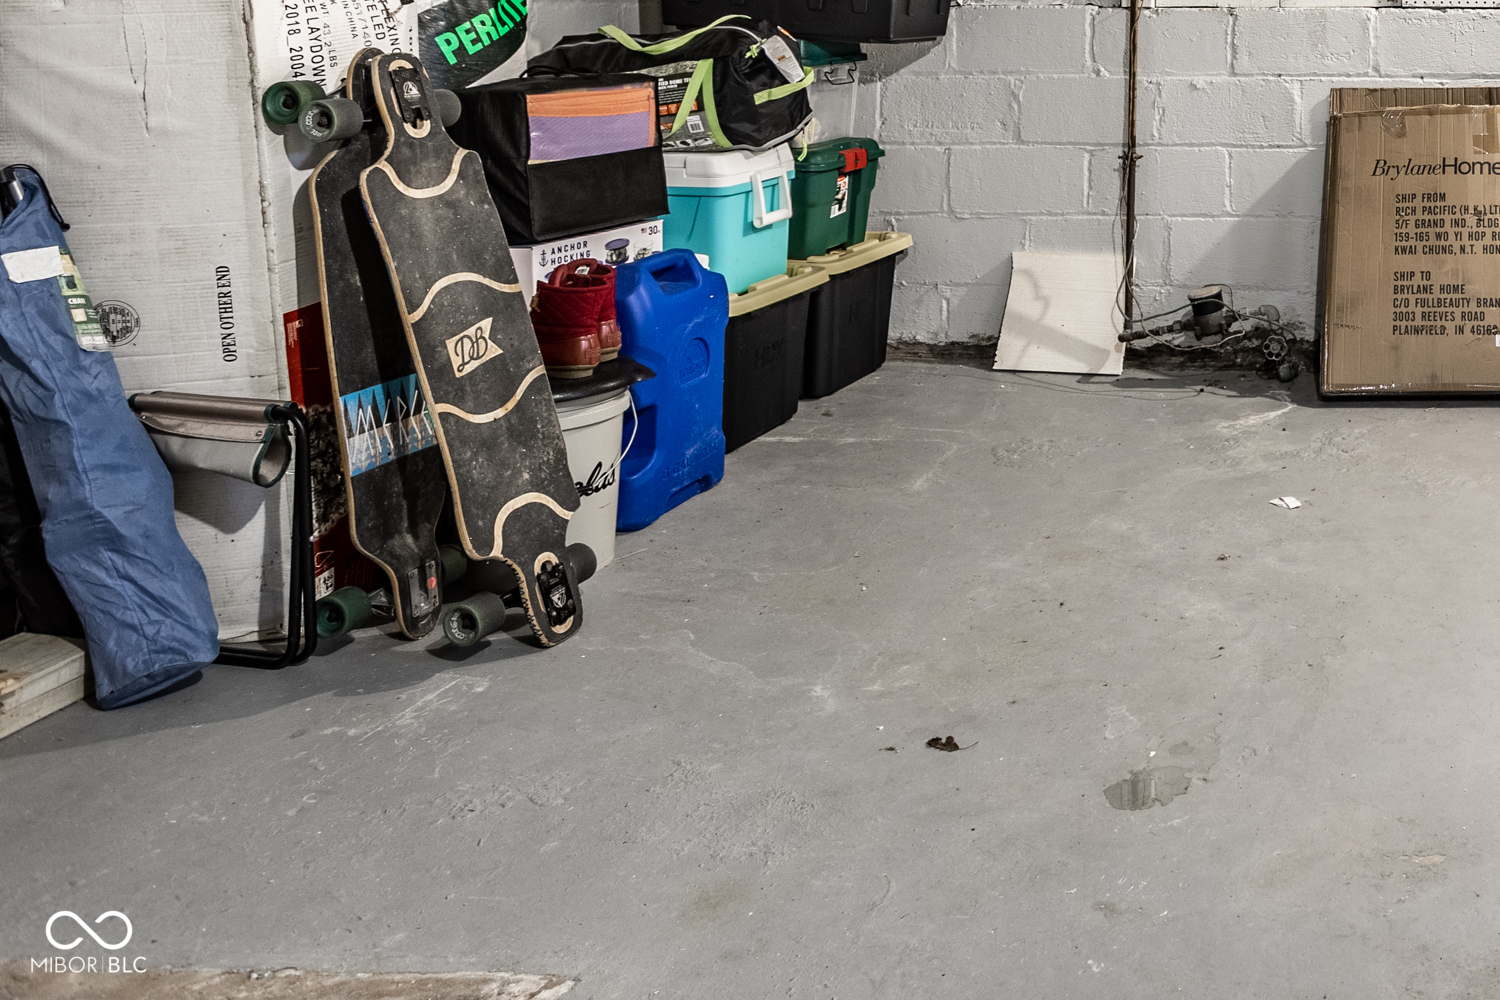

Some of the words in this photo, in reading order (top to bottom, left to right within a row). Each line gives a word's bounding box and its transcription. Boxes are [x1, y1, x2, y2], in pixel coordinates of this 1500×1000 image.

[341, 0, 350, 9] IN
[345, 11, 359, 40] CHINA
[370, 15, 387, 41] LED
[328, 49, 339, 69] LBS
[1395, 193, 1417, 204] SHIP
[1421, 192, 1446, 203] FROM
[1395, 206, 1417, 217] RICH
[1421, 205, 1457, 216] PACIFIC
[1394, 218, 1411, 230] 5/F
[1414, 218, 1445, 229] GRAND
[1450, 218, 1473, 230] IND.,
[1394, 231, 1430, 243] 159-165
[1435, 231, 1449, 242] WO
[1453, 231, 1463, 242] YI
[1468, 231, 1487, 242] HOP
[550, 240, 588, 256] ANCHOR
[1394, 244, 1417, 256] KWAI
[1422, 244, 1458, 257] CHUNG,
[1459, 244, 1477, 255] N.T.
[550, 250, 592, 267] HOCKING
[215, 265, 232, 289] END
[1393, 271, 1416, 282] SHIP
[1420, 271, 1431, 282] TO
[1393, 284, 1434, 295] BRYLANE
[1439, 284, 1466, 295] HOME
[1392, 298, 1410, 309] C/O
[1415, 297, 1472, 308] FULLBEAUTY
[217, 291, 235, 331] OTHER
[1392, 311, 1416, 322] 3003
[1421, 311, 1456, 322] REEVES
[1461, 311, 1486, 322] ROAD
[1454, 324, 1465, 336] IN
[221, 333, 238, 363] OPEN
